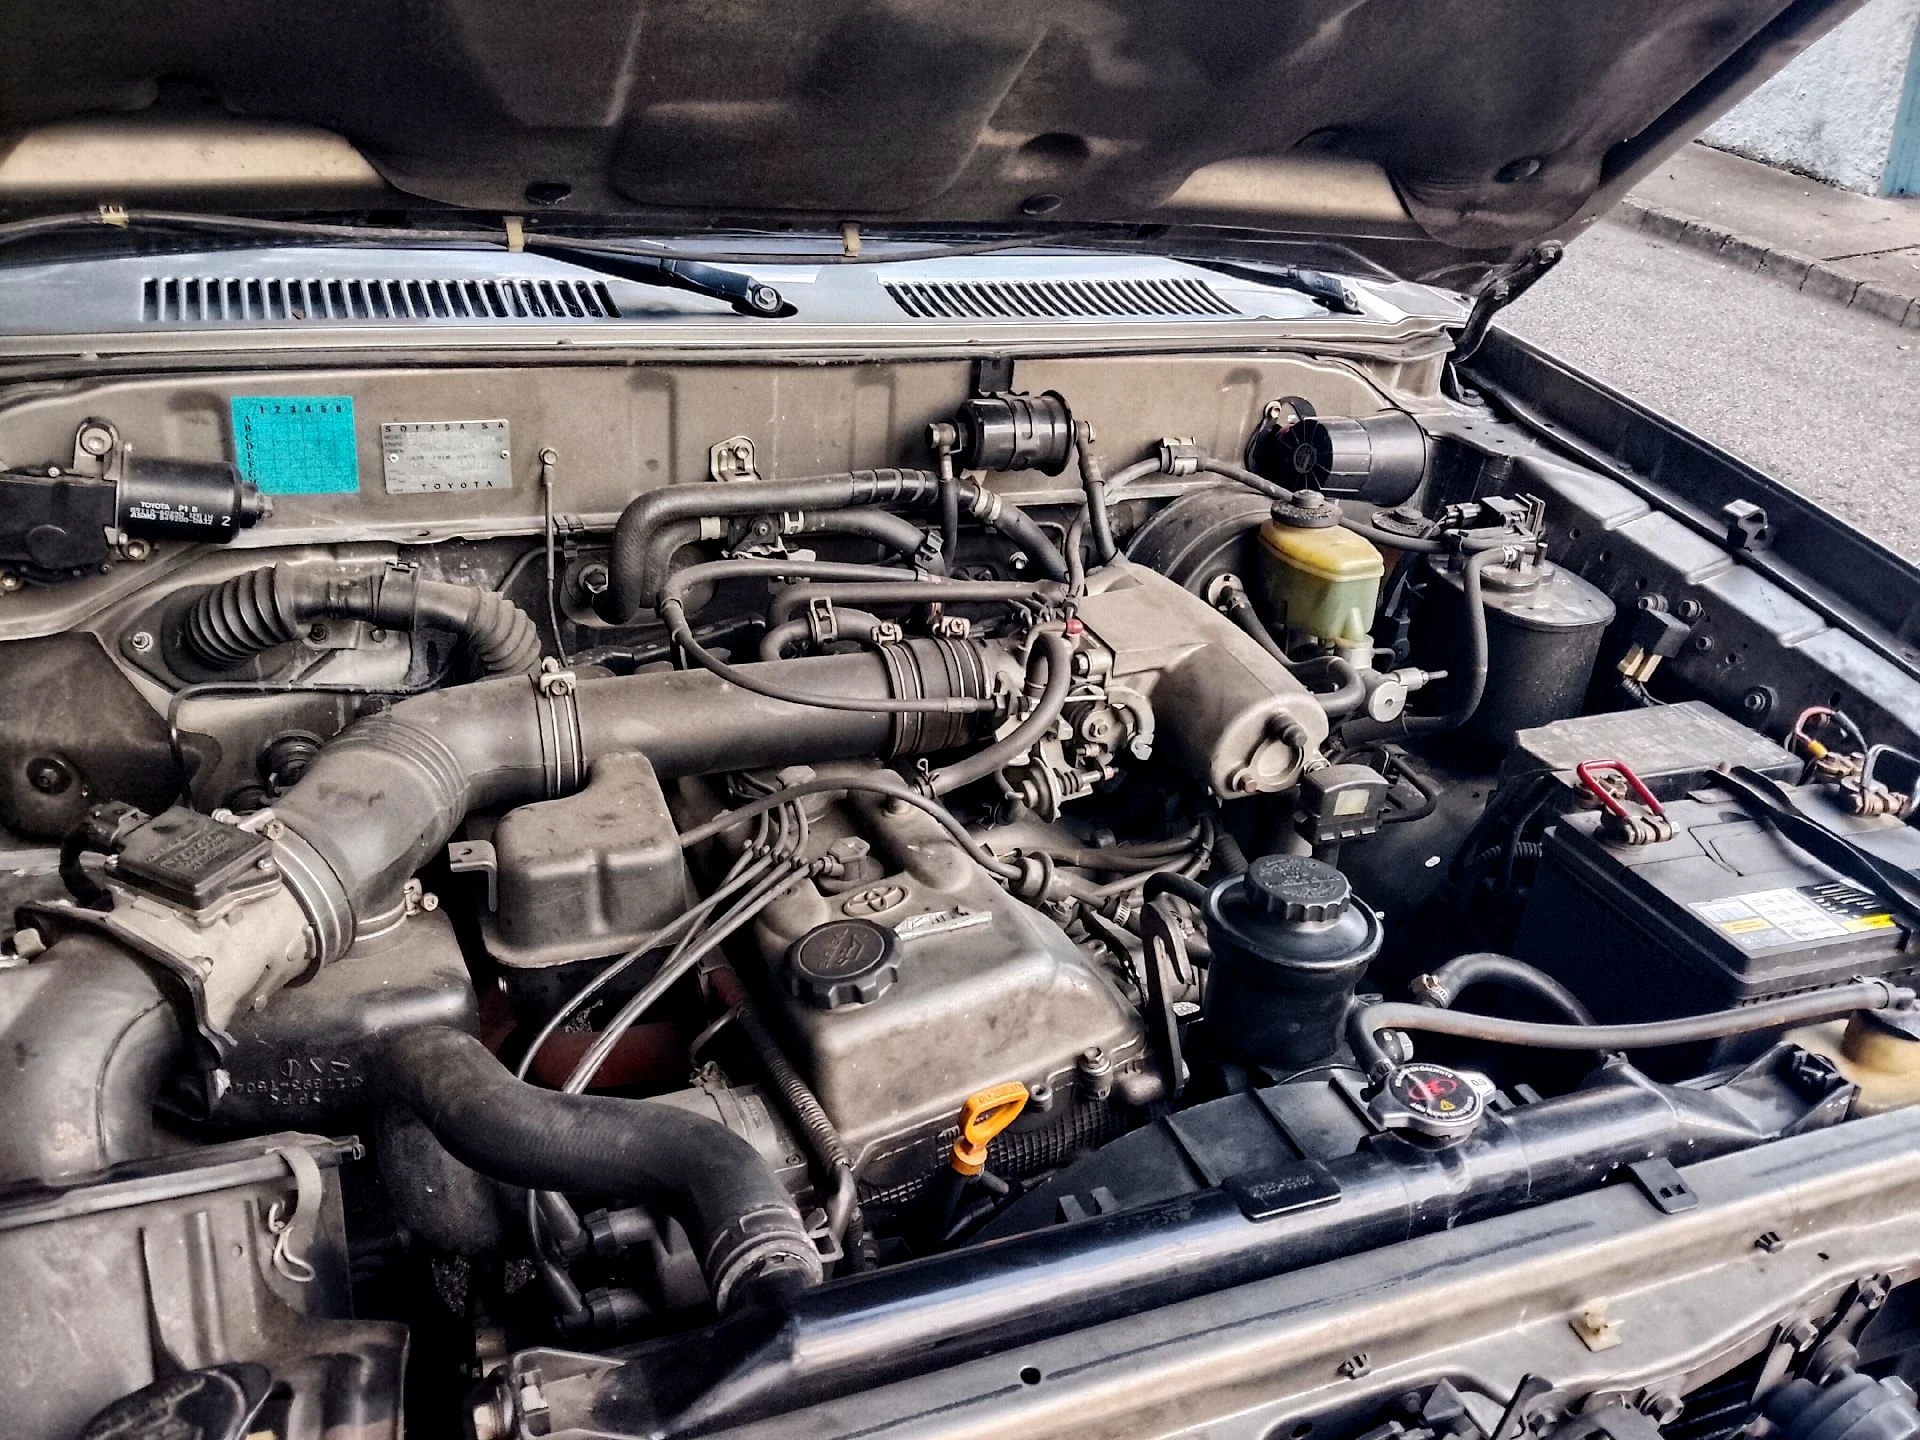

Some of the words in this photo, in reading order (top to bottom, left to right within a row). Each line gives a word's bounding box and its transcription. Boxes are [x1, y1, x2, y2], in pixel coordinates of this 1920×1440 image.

[275, 405, 281, 414] 2
[290, 404, 296, 414] 3
[305, 404, 311, 413] 4
[321, 405, 327, 413] 5
[336, 404, 342, 413] 6
[421, 480, 493, 490] TOYOTA
[140, 501, 170, 511] TOYOTA
[221, 515, 231, 526] 2
[1419, 1066, 1454, 1079] CALIENTE
